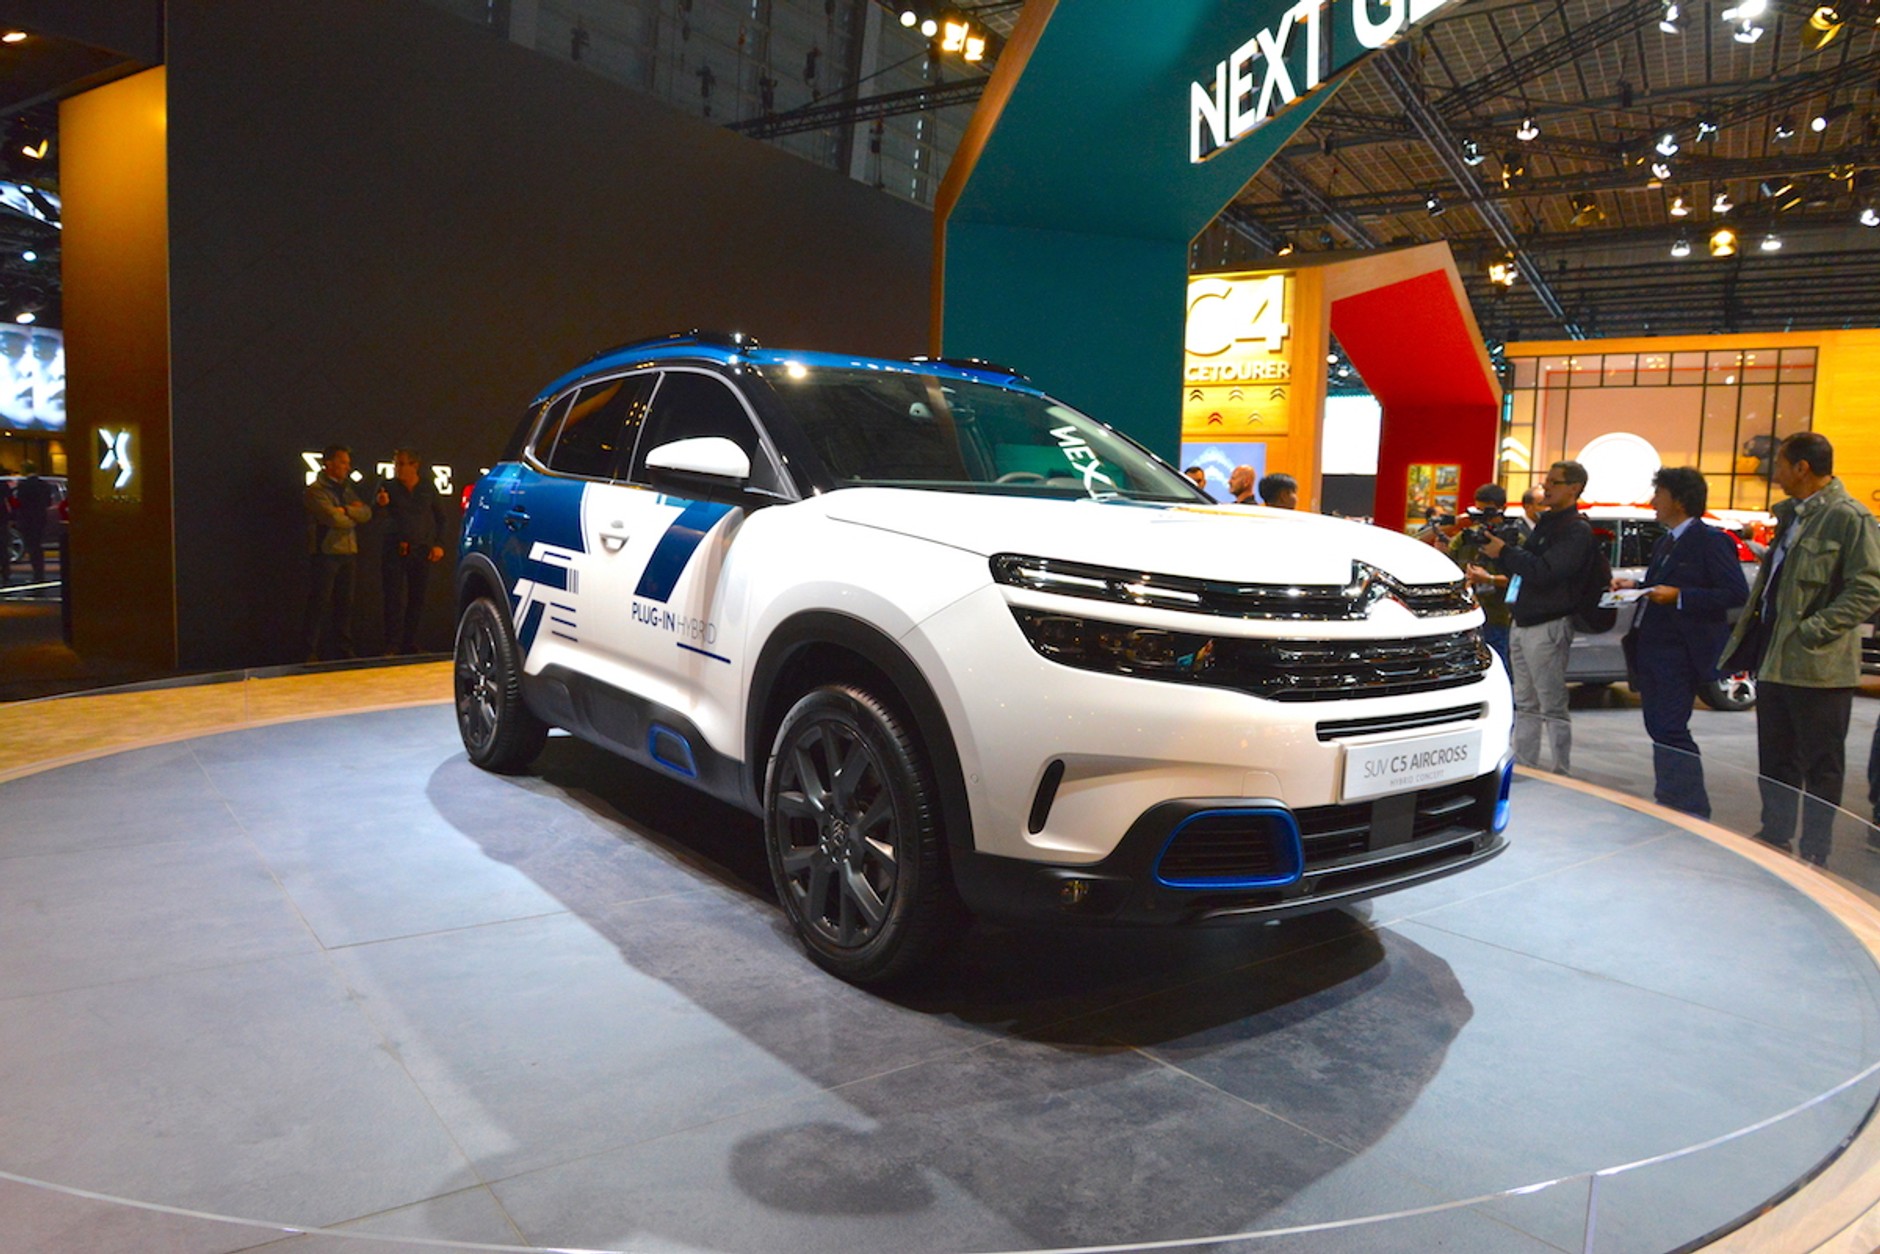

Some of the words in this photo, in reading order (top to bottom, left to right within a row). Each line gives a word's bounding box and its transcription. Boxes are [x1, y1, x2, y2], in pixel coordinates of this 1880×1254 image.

[1190, 0, 1327, 162] NEXT
[1352, 0, 1448, 49] G
[1186, 275, 1291, 358] C4
[632, 602, 675, 632] PLUG-IN
[1364, 758, 1388, 778] SUV
[1390, 755, 1407, 773] C5
[1410, 744, 1467, 770] AIRCROSS
